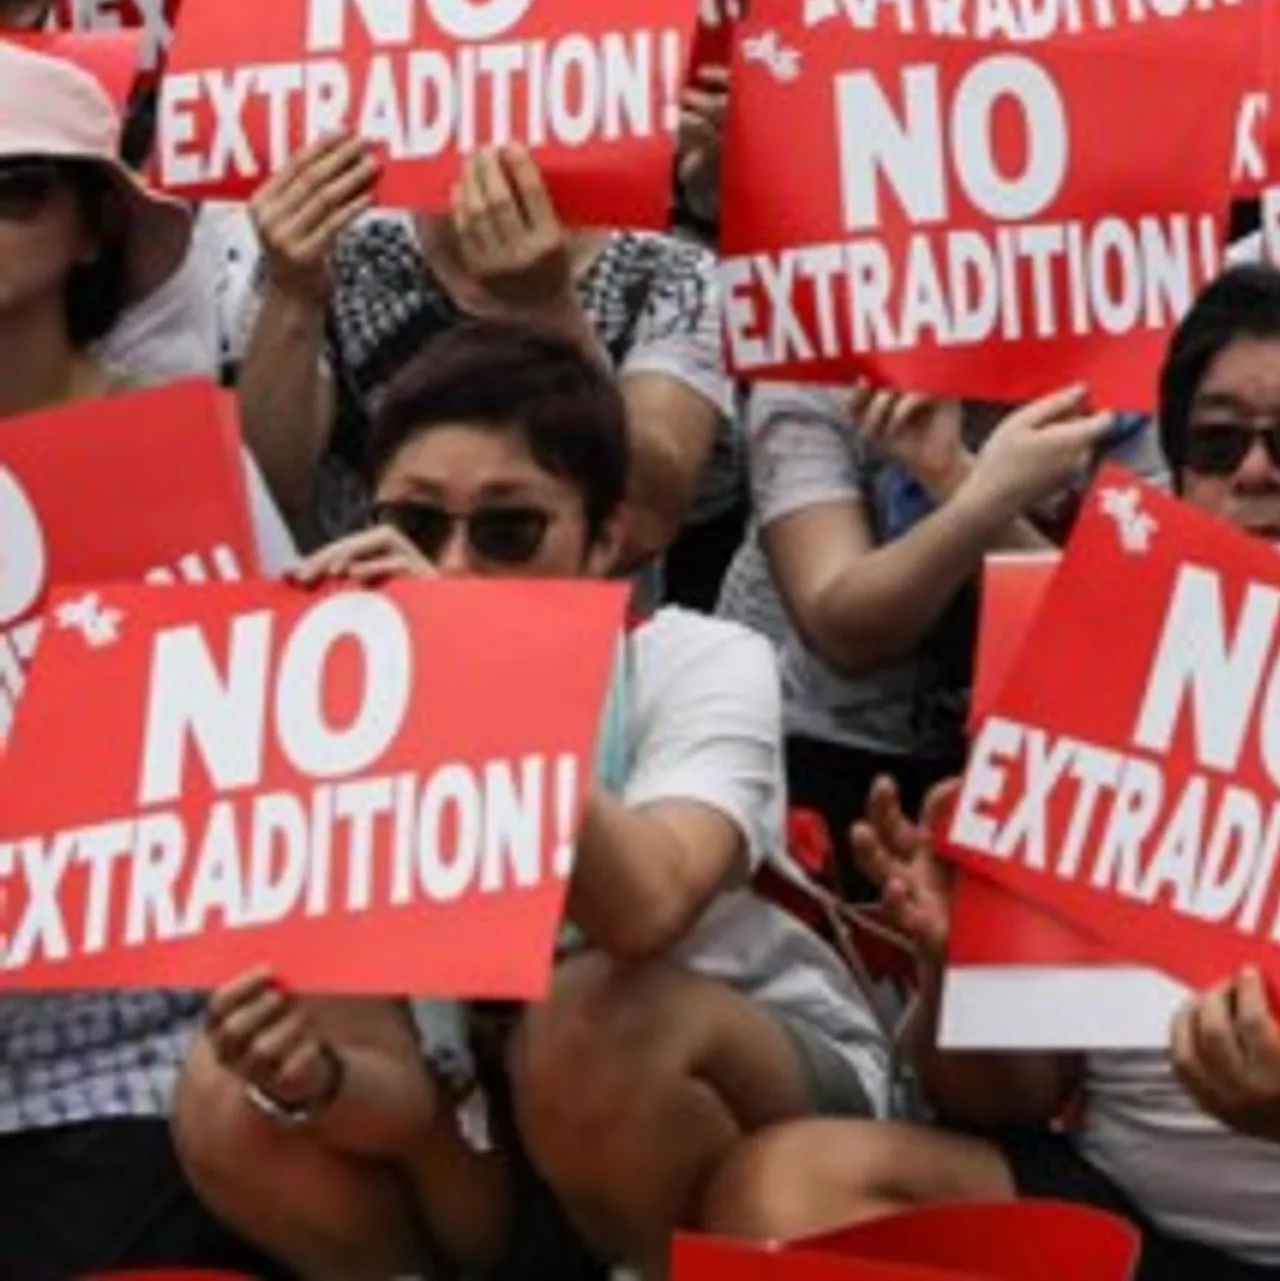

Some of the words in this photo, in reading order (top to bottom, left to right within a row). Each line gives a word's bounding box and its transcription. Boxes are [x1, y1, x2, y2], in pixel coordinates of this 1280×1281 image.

[159, 27, 684, 188] EXTRADITION!
[833, 52, 1070, 232] NO
[723, 213, 1218, 371] EXTRADITION!
[137, 590, 413, 808] NO
